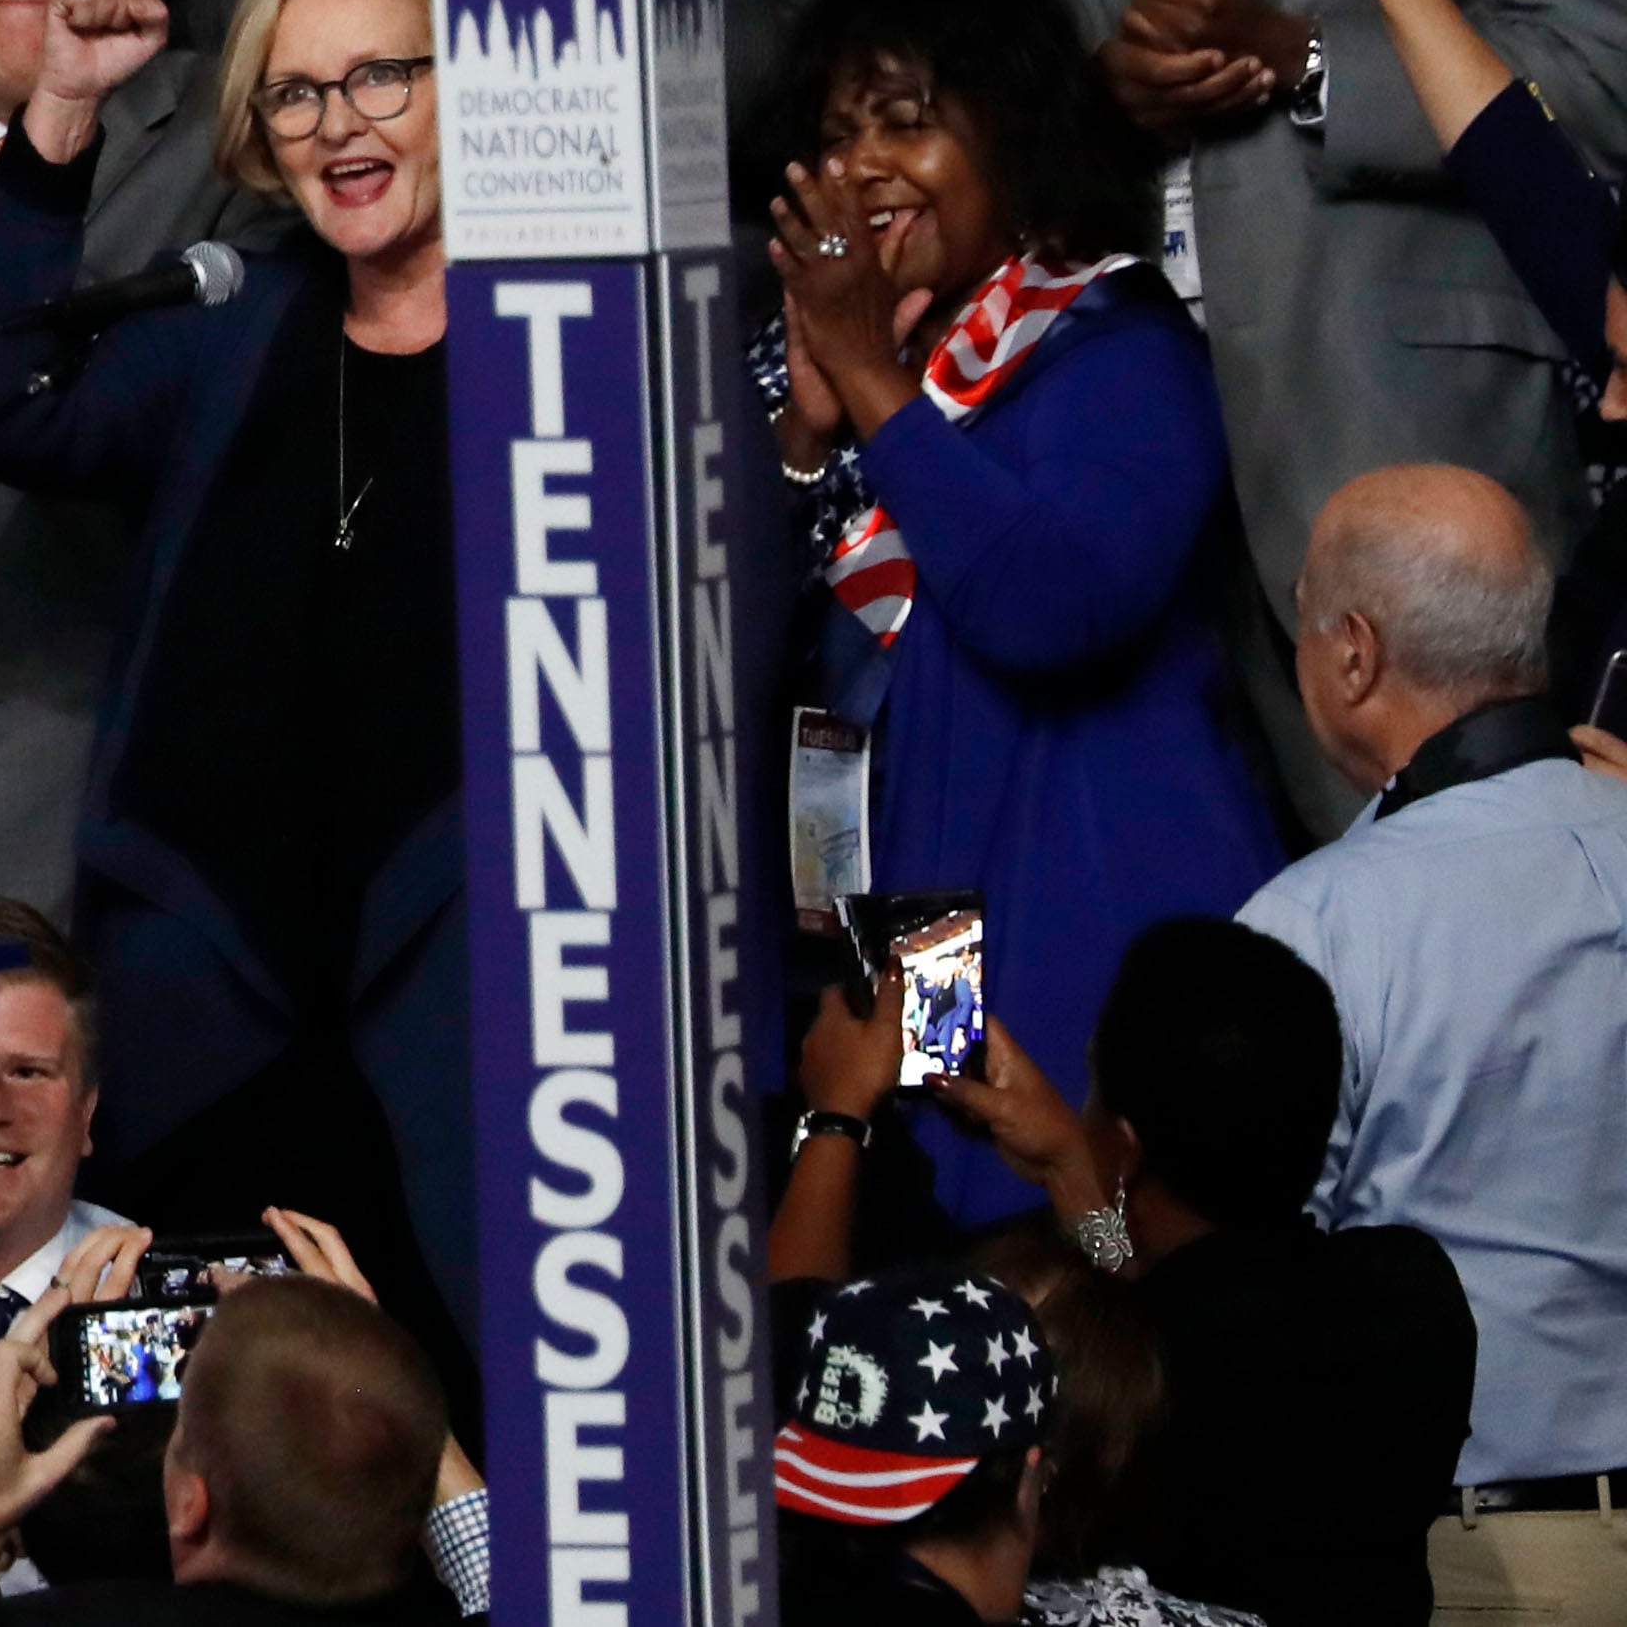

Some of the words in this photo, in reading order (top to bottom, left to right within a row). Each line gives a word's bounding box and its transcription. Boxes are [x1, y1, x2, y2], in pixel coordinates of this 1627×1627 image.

[459, 86, 620, 118] DEMOCRATIC
[460, 124, 621, 160] NATIONAL
[463, 168, 624, 199] CONVENTION
[463, 222, 626, 244] PHILADELPHIA
